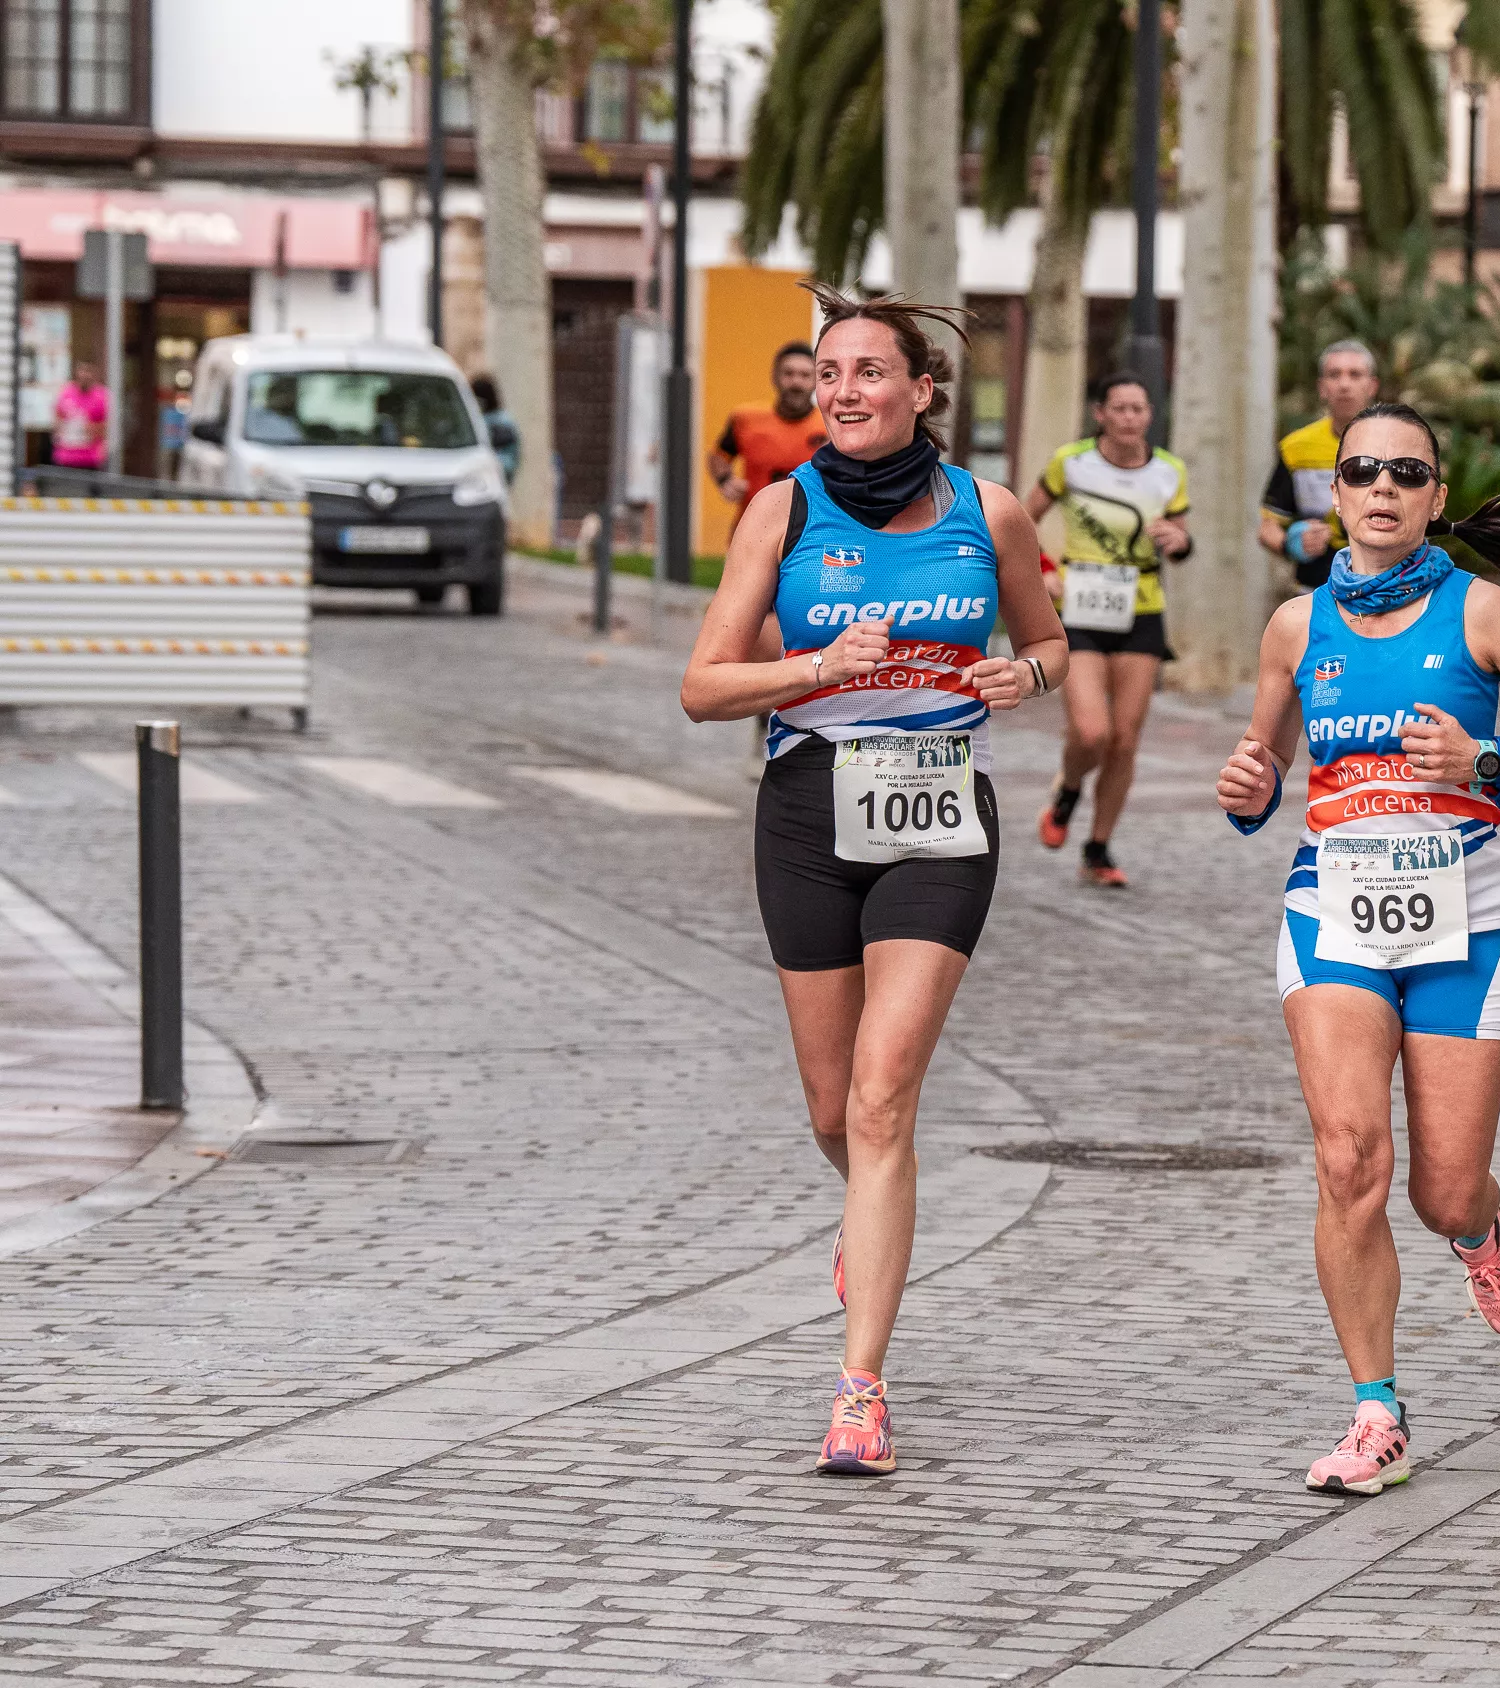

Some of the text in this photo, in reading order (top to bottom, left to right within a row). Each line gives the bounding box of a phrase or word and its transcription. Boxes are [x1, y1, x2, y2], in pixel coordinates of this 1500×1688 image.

[807, 594, 985, 626] enerplus
[884, 643, 958, 664] ratón
[842, 741, 916, 750] CAERAS POPULARES
[916, 735, 947, 751] 2024
[857, 790, 962, 832] 1006
[1343, 794, 1432, 819] Lucena
[1348, 839, 1379, 847] PROVINCIAL
[1390, 836, 1431, 854] 2024
[1350, 893, 1435, 934] 969
[1355, 942, 1380, 950] CARMEN
